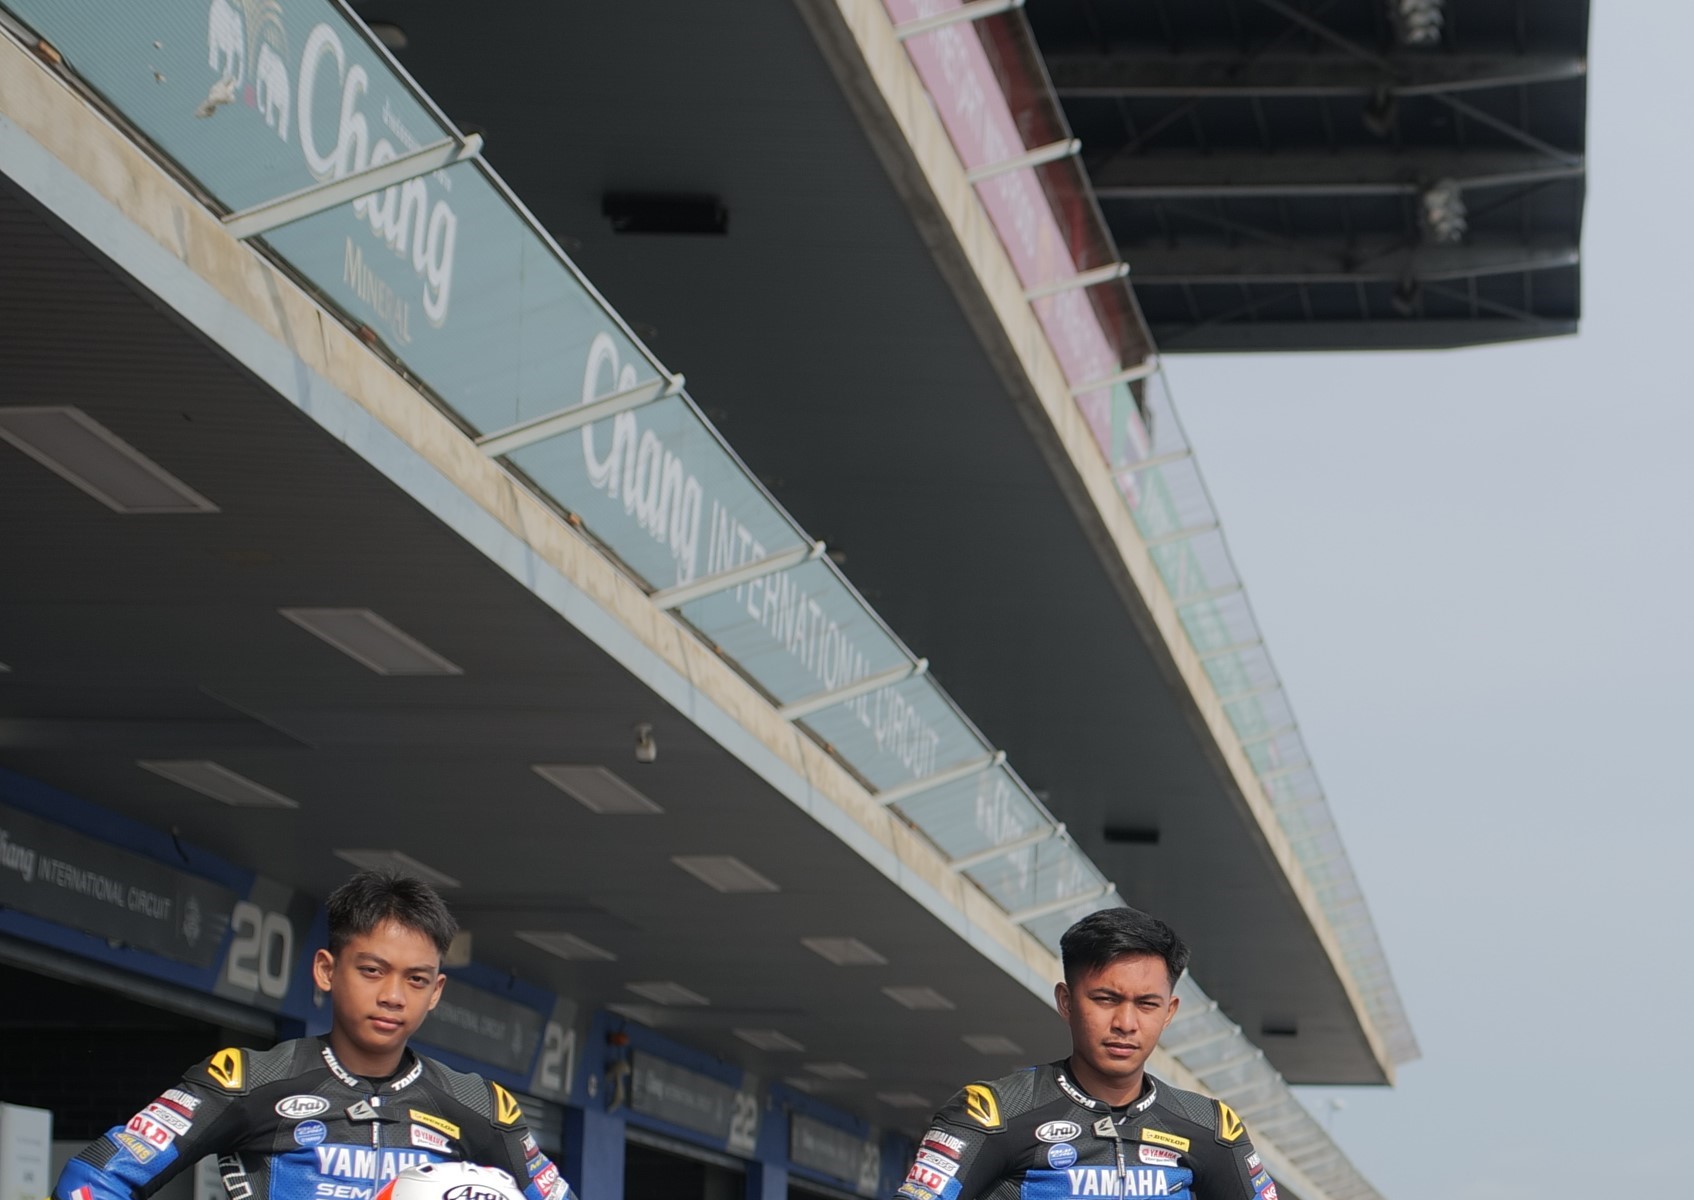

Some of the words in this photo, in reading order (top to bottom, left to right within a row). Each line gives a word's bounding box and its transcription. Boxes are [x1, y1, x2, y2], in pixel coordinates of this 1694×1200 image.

[581, 333, 703, 587] Chang
[37, 857, 126, 913] INTERNATIONAL
[128, 884, 172, 921] CIRCUIT
[228, 902, 293, 998] 20
[541, 1023, 577, 1094] 21
[283, 1100, 320, 1112] Arai
[1057, 1074, 1097, 1109] TAICHI
[1044, 1122, 1076, 1136] Arai
[1153, 1133, 1187, 1148] DUNLOP
[1150, 1149, 1178, 1160] YAMAHA
[1068, 1169, 1169, 1197] YAMAHA
